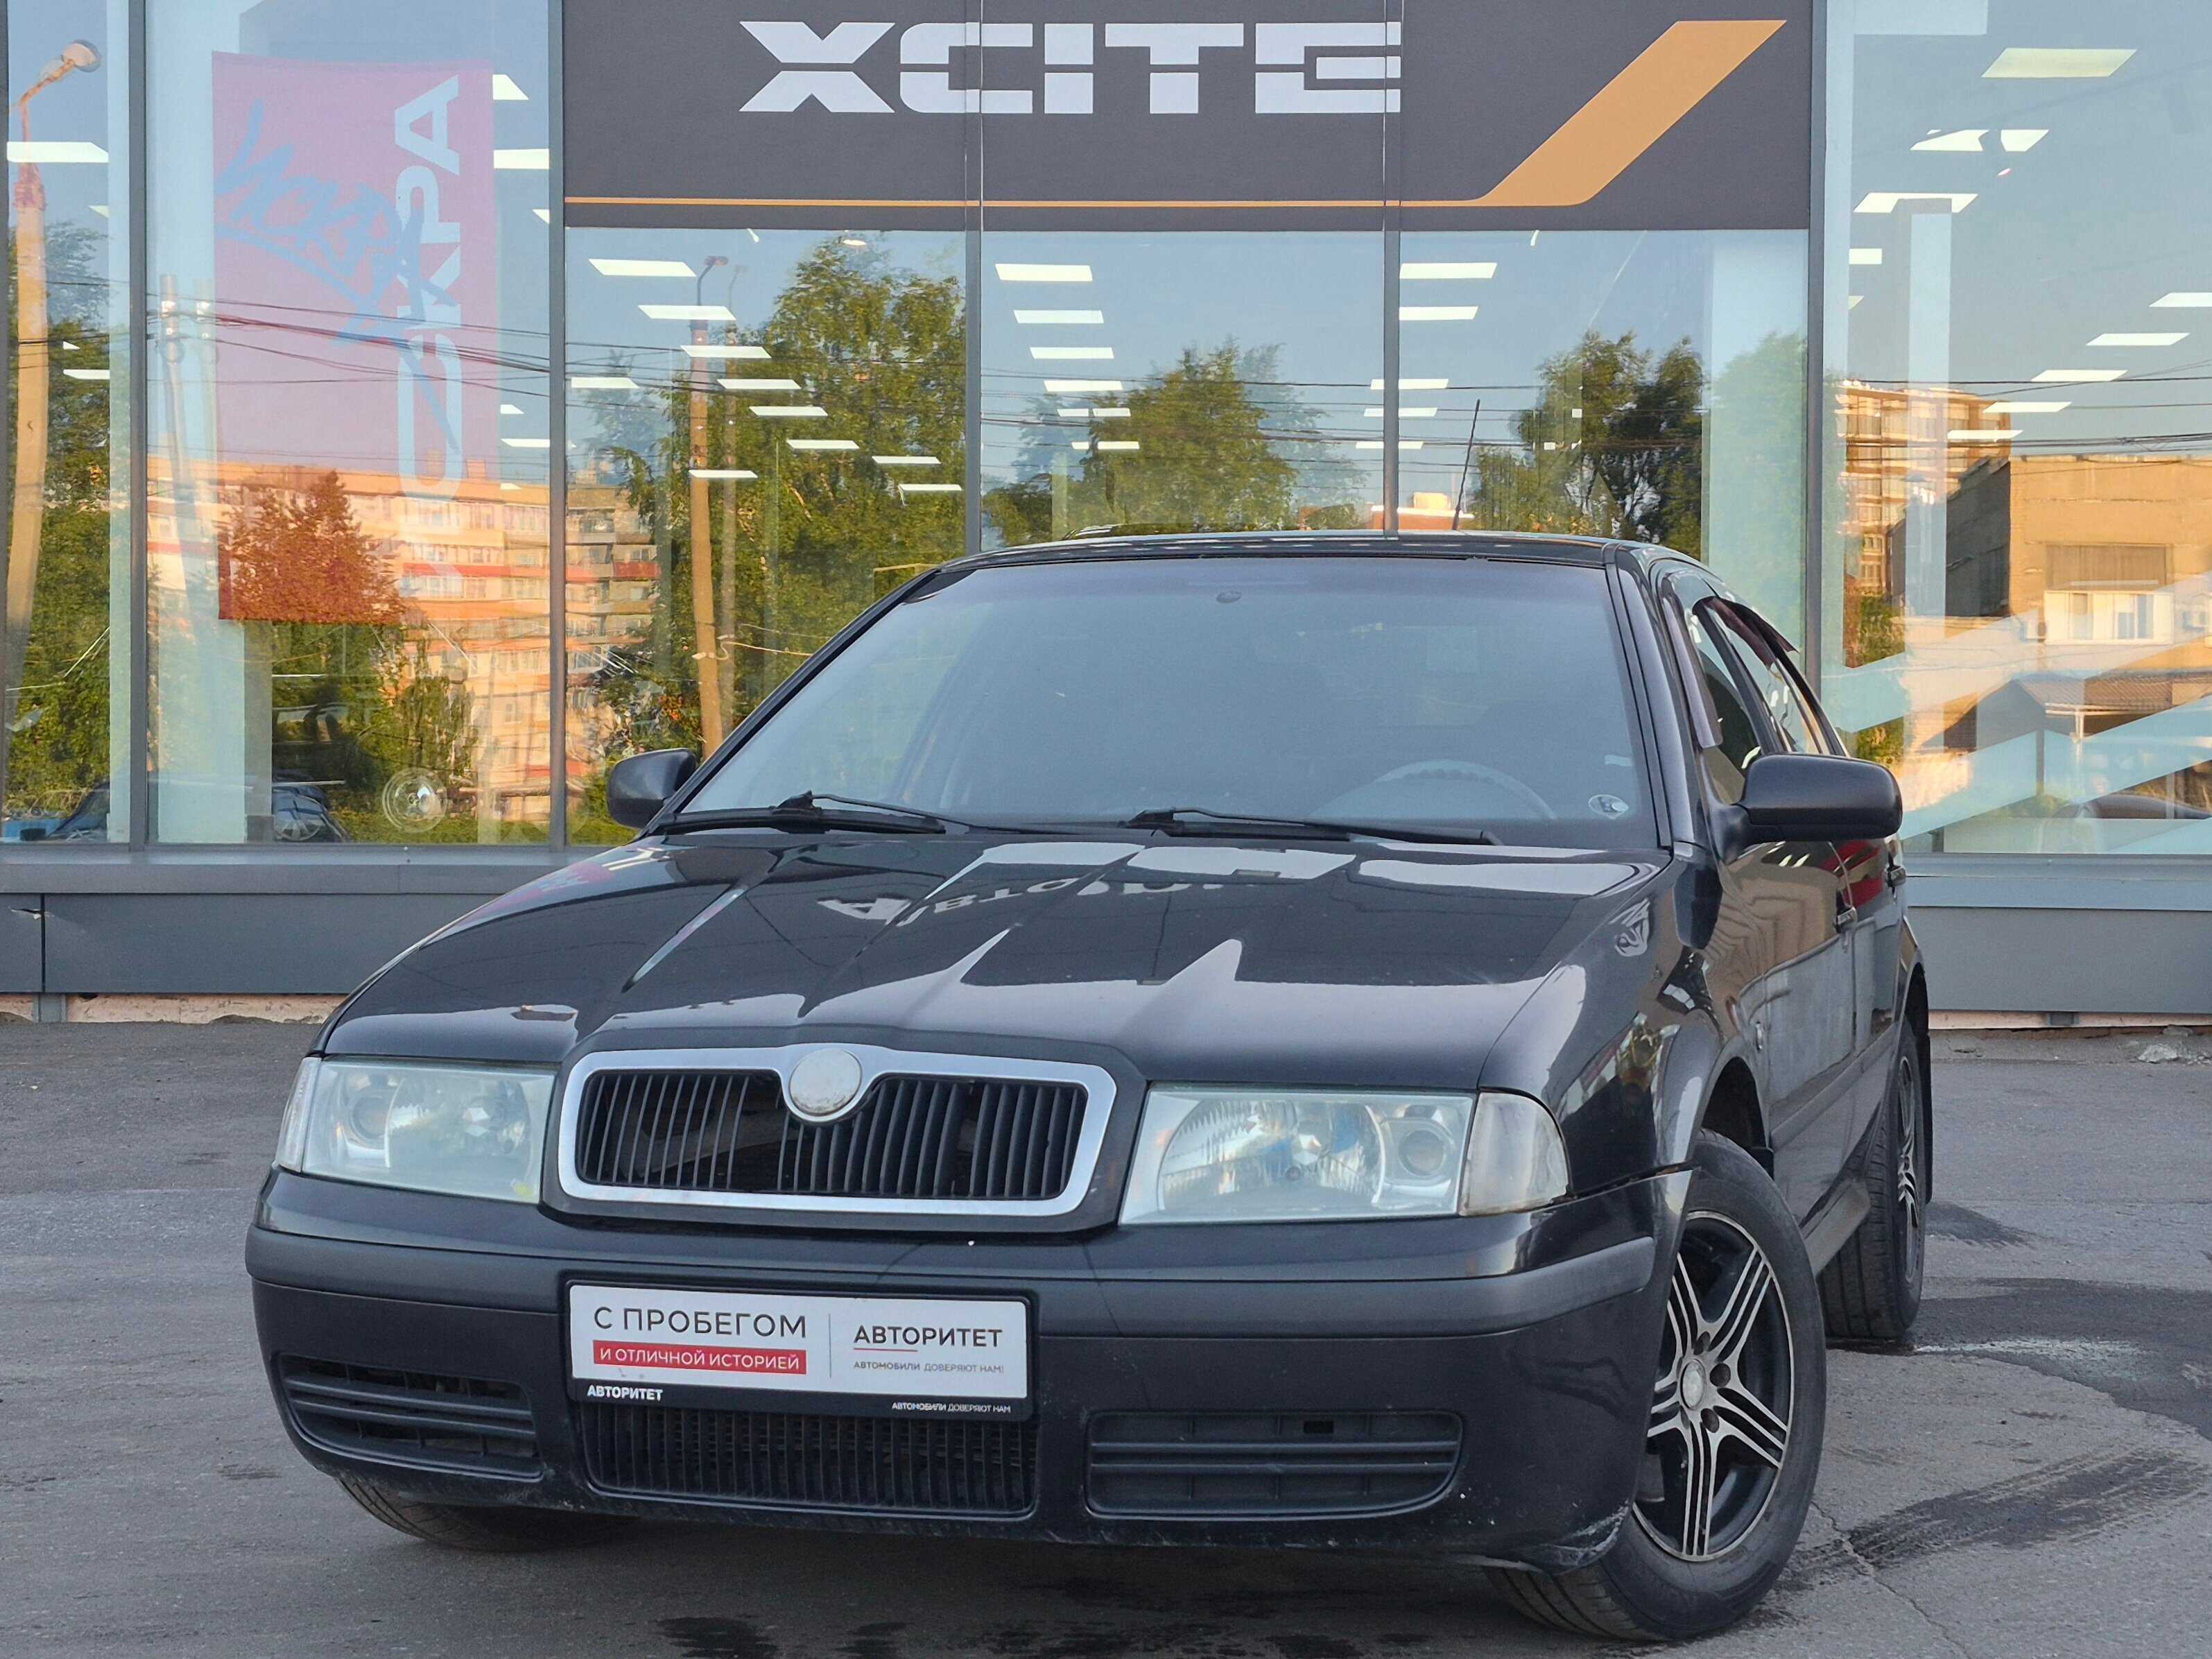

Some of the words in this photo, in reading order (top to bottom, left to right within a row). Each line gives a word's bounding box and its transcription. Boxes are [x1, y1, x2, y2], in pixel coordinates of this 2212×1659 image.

[739, 22, 1401, 114] XCITE
[594, 1306, 613, 1330] С
[623, 1307, 806, 1339] ПРОБЕГОМ
[853, 1325, 1003, 1348] АВТОРИТЕТ
[600, 1348, 611, 1361] И
[614, 1348, 705, 1366] ОТЛИЧНОЙ
[709, 1353, 800, 1370] ИСТОРИЕЙ
[853, 1360, 921, 1371] АВТОМОБИЛИ
[924, 1362, 978, 1373] ДОВЕРЯЮТ
[980, 1364, 1004, 1373] НАМ!
[587, 1384, 664, 1402] АВТОРИТЕТ
